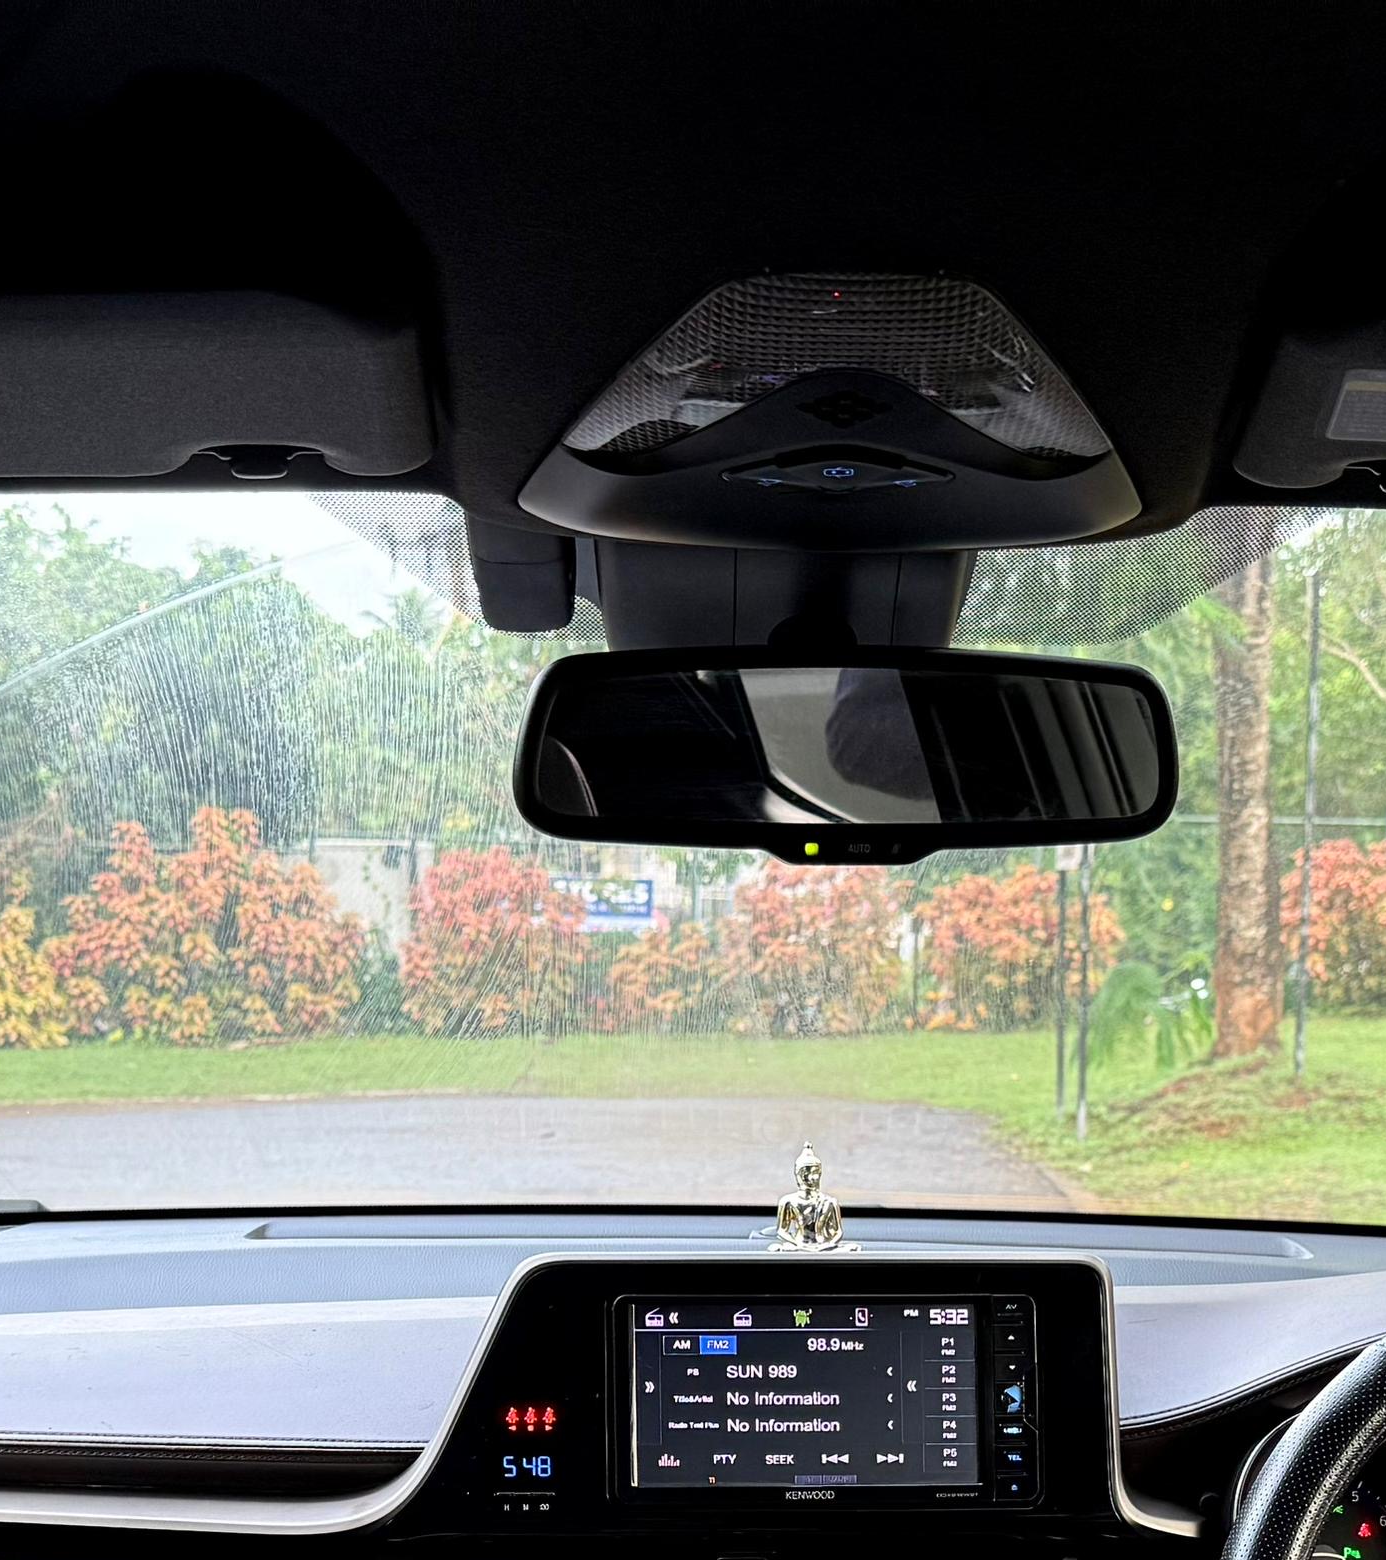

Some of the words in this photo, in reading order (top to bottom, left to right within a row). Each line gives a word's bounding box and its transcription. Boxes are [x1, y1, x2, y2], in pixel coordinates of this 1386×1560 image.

[847, 843, 871, 854] AUTO
[903, 1308, 919, 1318] PM
[929, 1308, 969, 1325] 5:32
[672, 1339, 691, 1350] AM
[706, 1339, 729, 1350] FM2
[807, 1338, 840, 1352] 98.9
[941, 1337, 955, 1347] P1
[726, 1365, 763, 1379] SUN
[768, 1365, 798, 1379] 989
[941, 1365, 956, 1374] P2
[726, 1391, 750, 1405] No
[755, 1391, 840, 1405] Information
[941, 1393, 957, 1402] P3
[727, 1418, 750, 1432] No
[755, 1418, 841, 1432] Information
[942, 1420, 957, 1429] P4
[713, 1454, 737, 1465] PTY
[765, 1454, 795, 1465] SEEK
[785, 1490, 835, 1500] KENWOOD
[1351, 1491, 1359, 1502] 5
